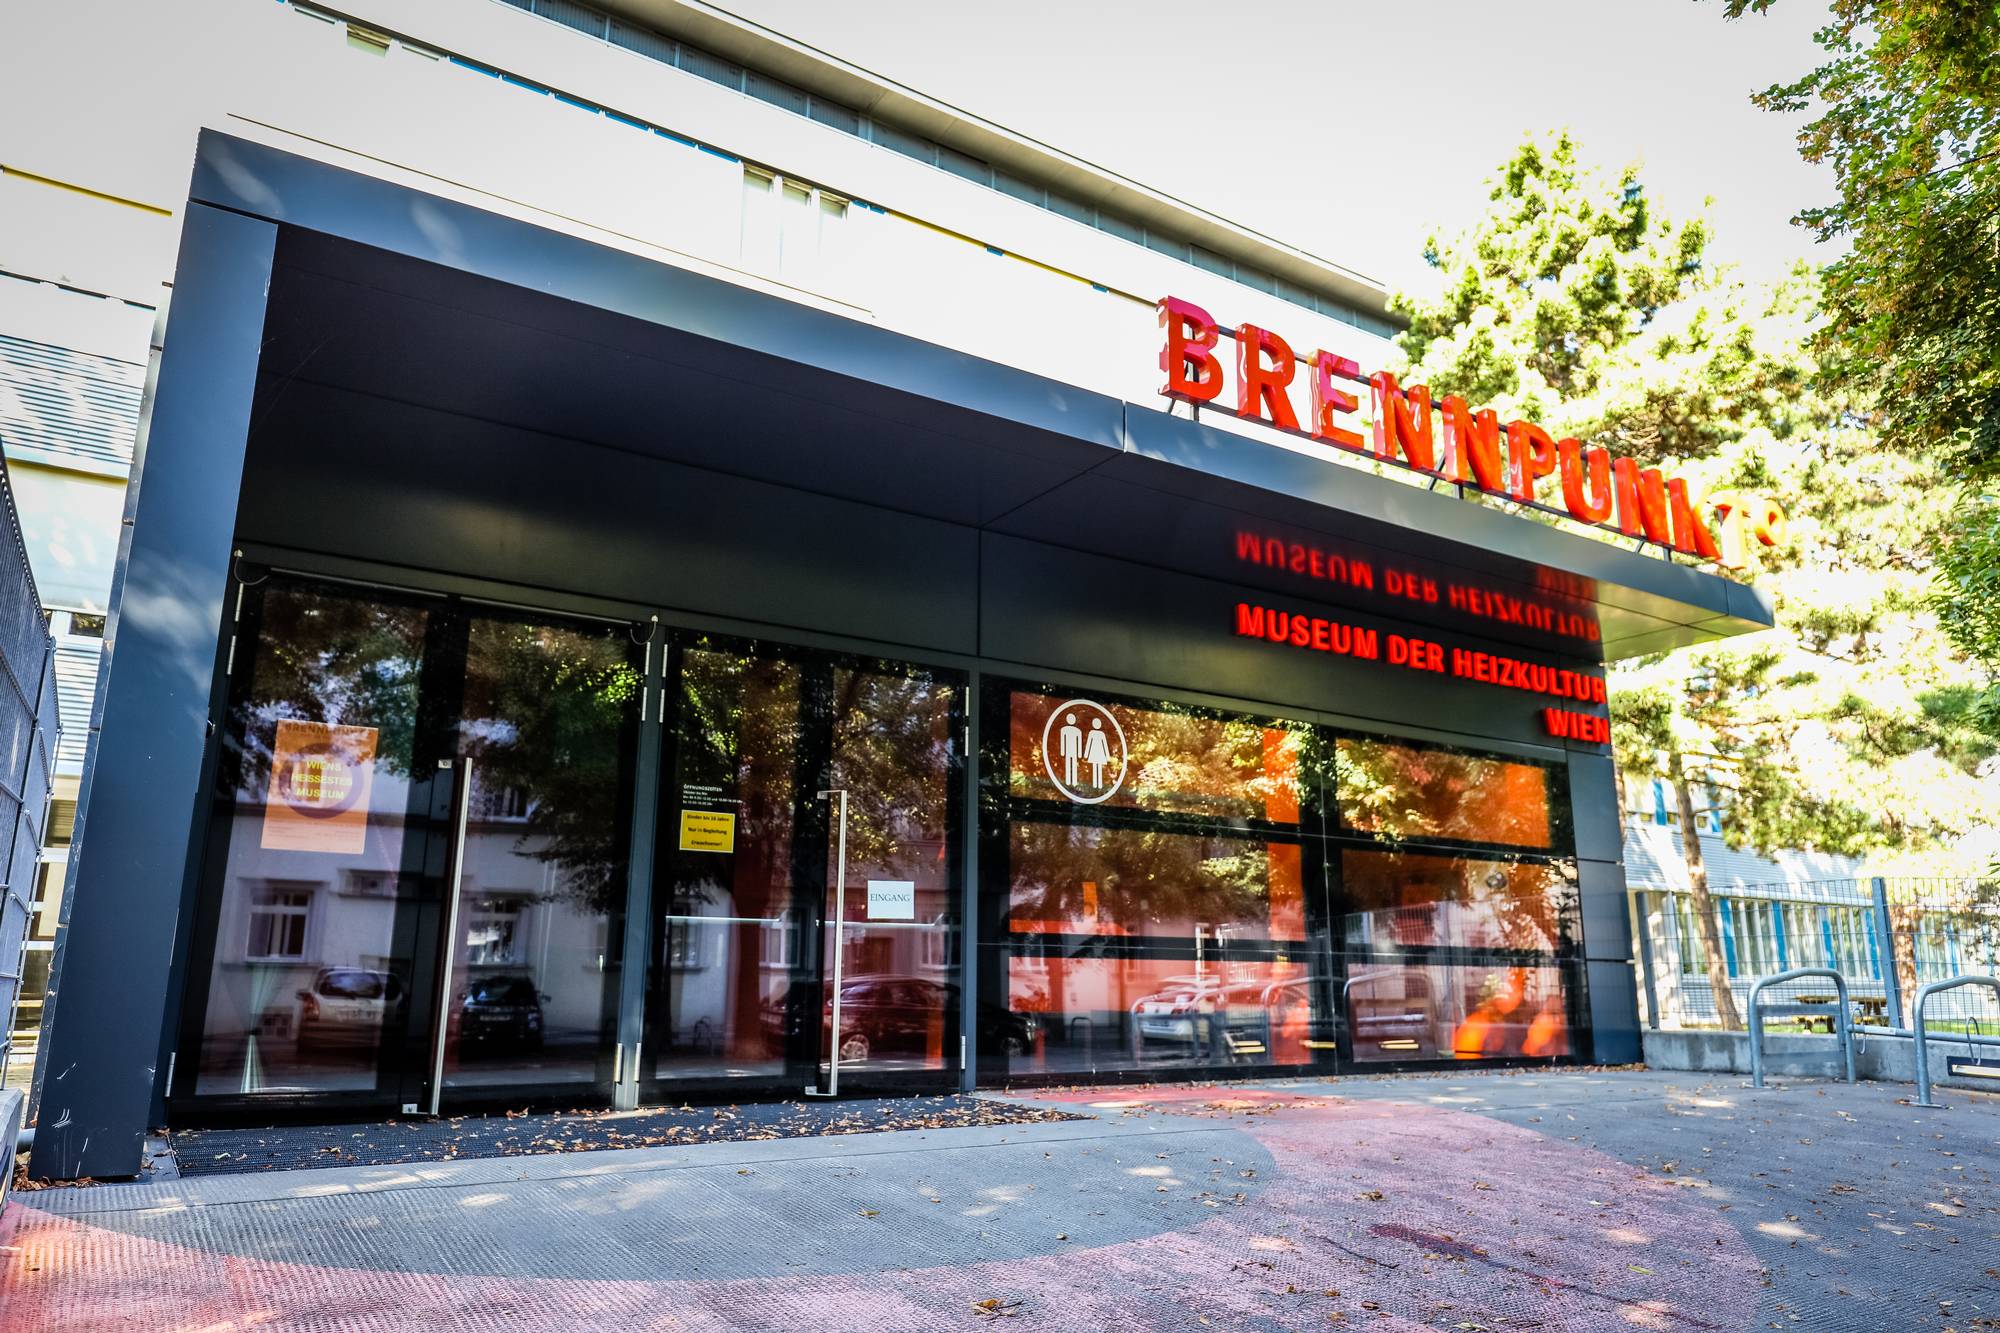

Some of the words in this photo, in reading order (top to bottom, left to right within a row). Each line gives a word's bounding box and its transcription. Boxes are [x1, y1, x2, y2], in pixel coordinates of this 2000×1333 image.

[1235, 602, 1379, 661] MUSEUM
[1386, 633, 1445, 673] DER
[1452, 647, 1607, 705] HEIZKULTUR
[1541, 706, 1611, 745] WIEN
[306, 760, 342, 771] WIENS
[296, 787, 345, 799] MUSEUM
[870, 893, 911, 902] EINGANG
